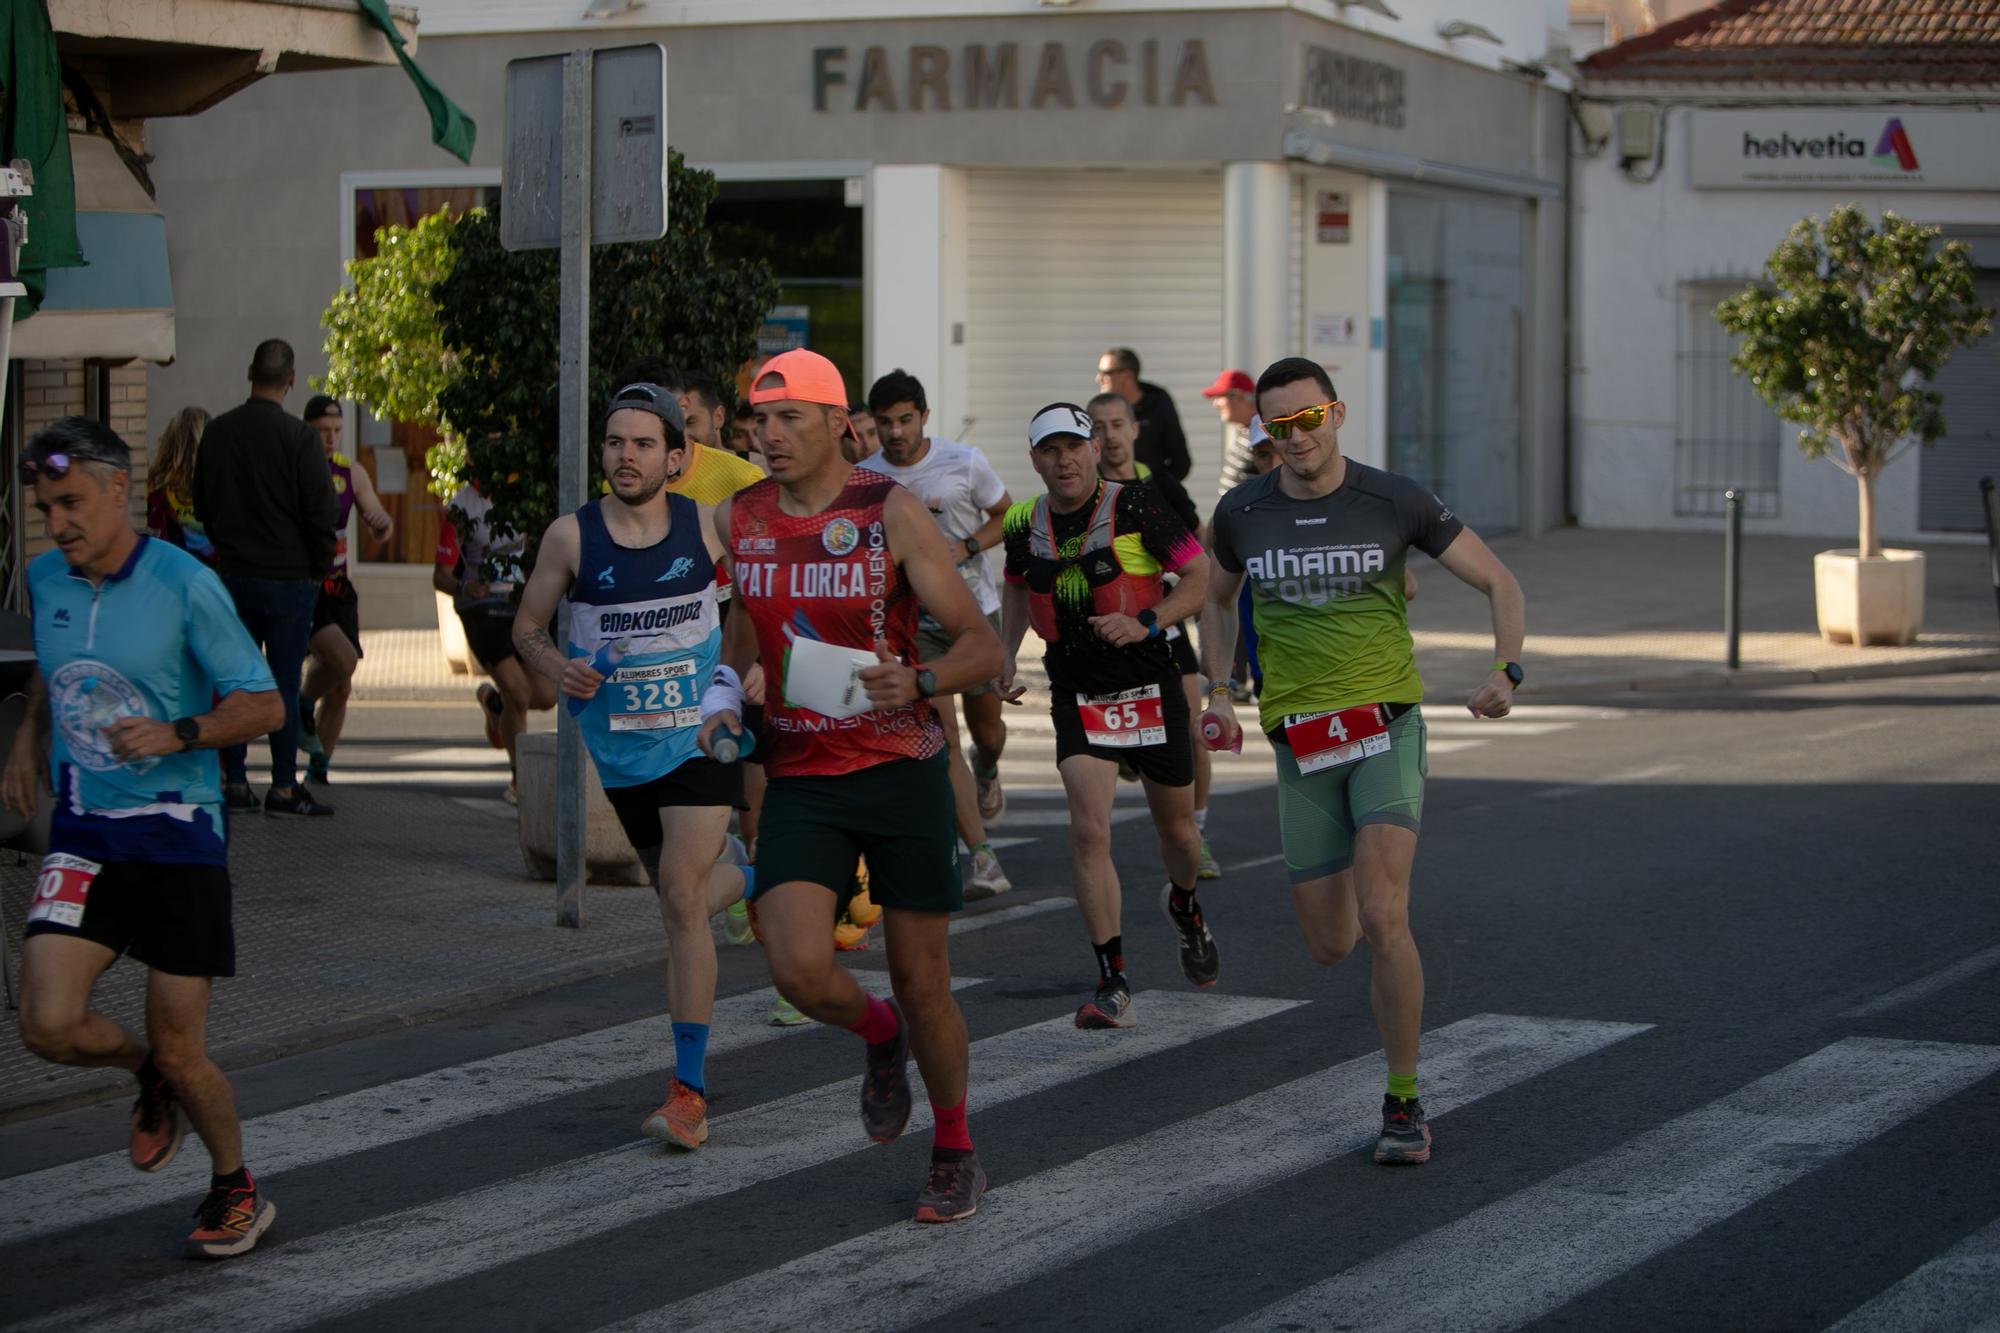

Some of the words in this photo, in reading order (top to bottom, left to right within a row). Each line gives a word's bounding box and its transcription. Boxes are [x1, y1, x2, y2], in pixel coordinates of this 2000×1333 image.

[812, 38, 1218, 112] FARMACIA
[1743, 130, 1865, 157] helvetia
[865, 521, 886, 596] SUEÑOS
[790, 562, 867, 598] LORCA
[621, 669, 662, 679] ALUMBRES
[664, 664, 689, 675] SPORT
[623, 680, 683, 712] 328
[1103, 702, 1140, 731] 65
[1327, 715, 1349, 743] 4
